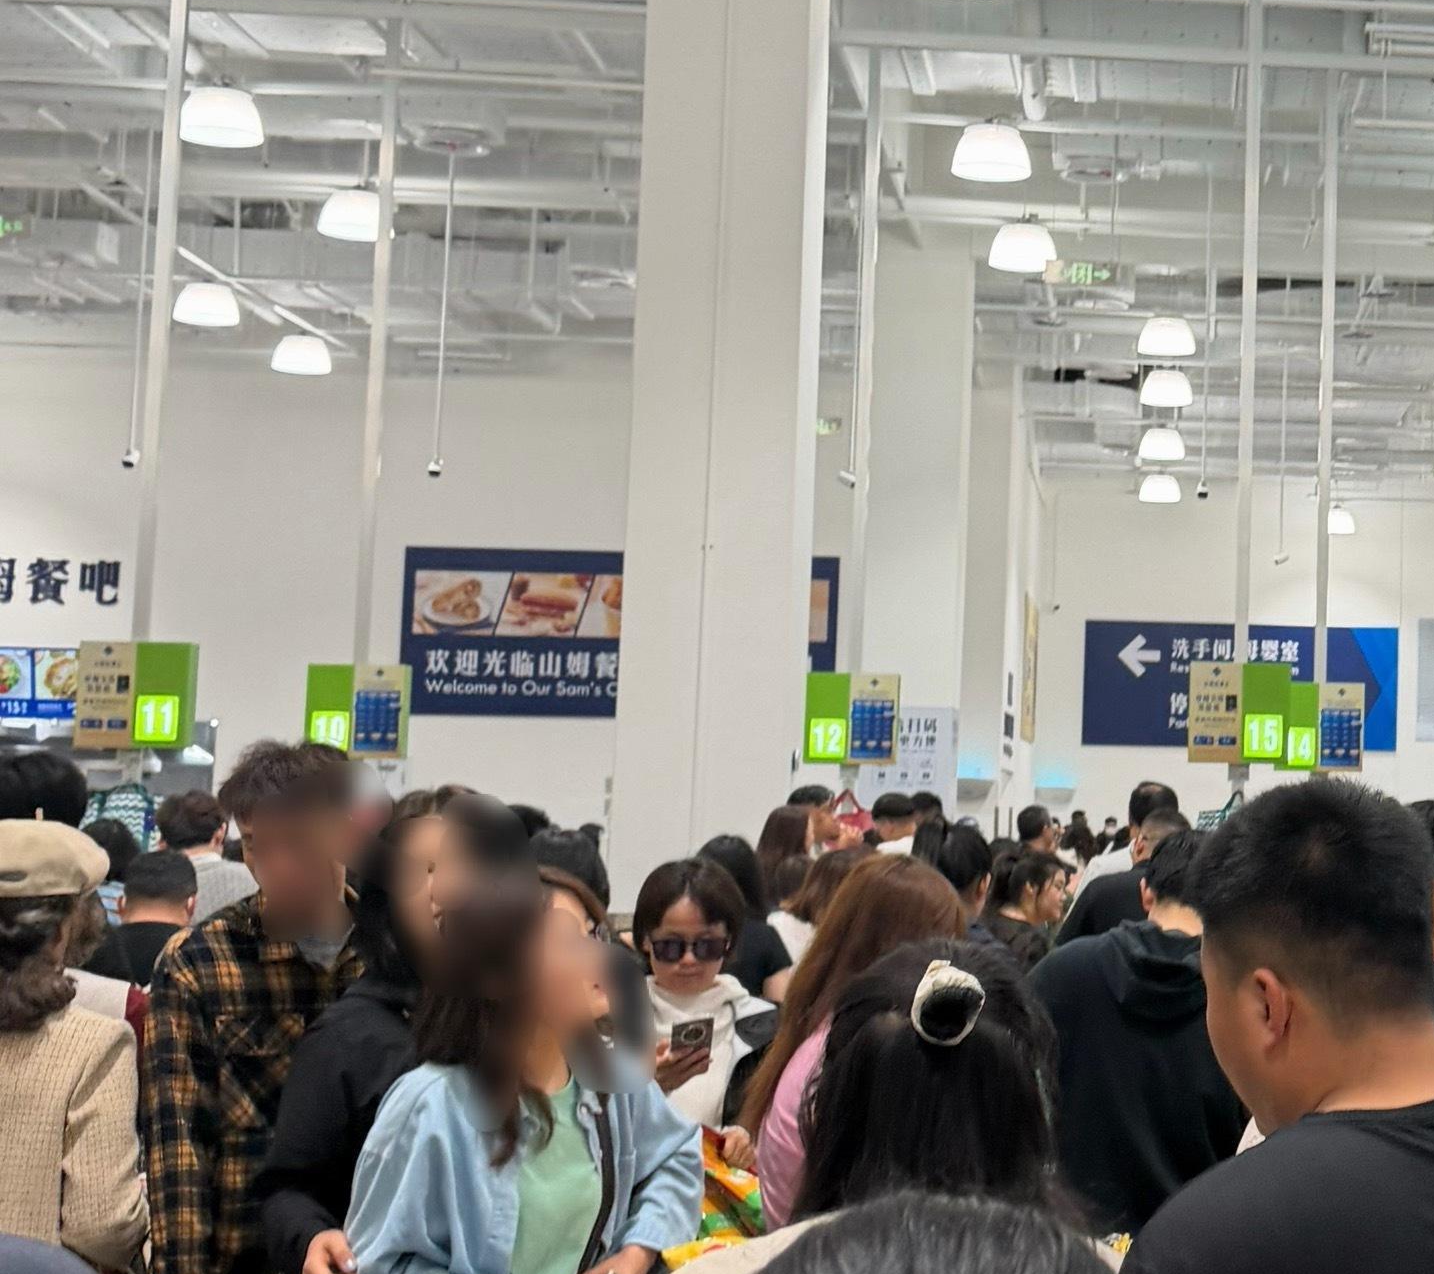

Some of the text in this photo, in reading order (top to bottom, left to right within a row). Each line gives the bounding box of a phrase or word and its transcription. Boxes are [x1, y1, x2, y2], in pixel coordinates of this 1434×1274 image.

[425, 678, 498, 695] Welcome
[502, 680, 517, 695] to
[522, 680, 552, 695] Our
[555, 682, 601, 697] Sam's
[142, 700, 174, 735] 11
[813, 723, 842, 754] 12
[1250, 719, 1279, 752] 15
[1287, 731, 1312, 762] 14
